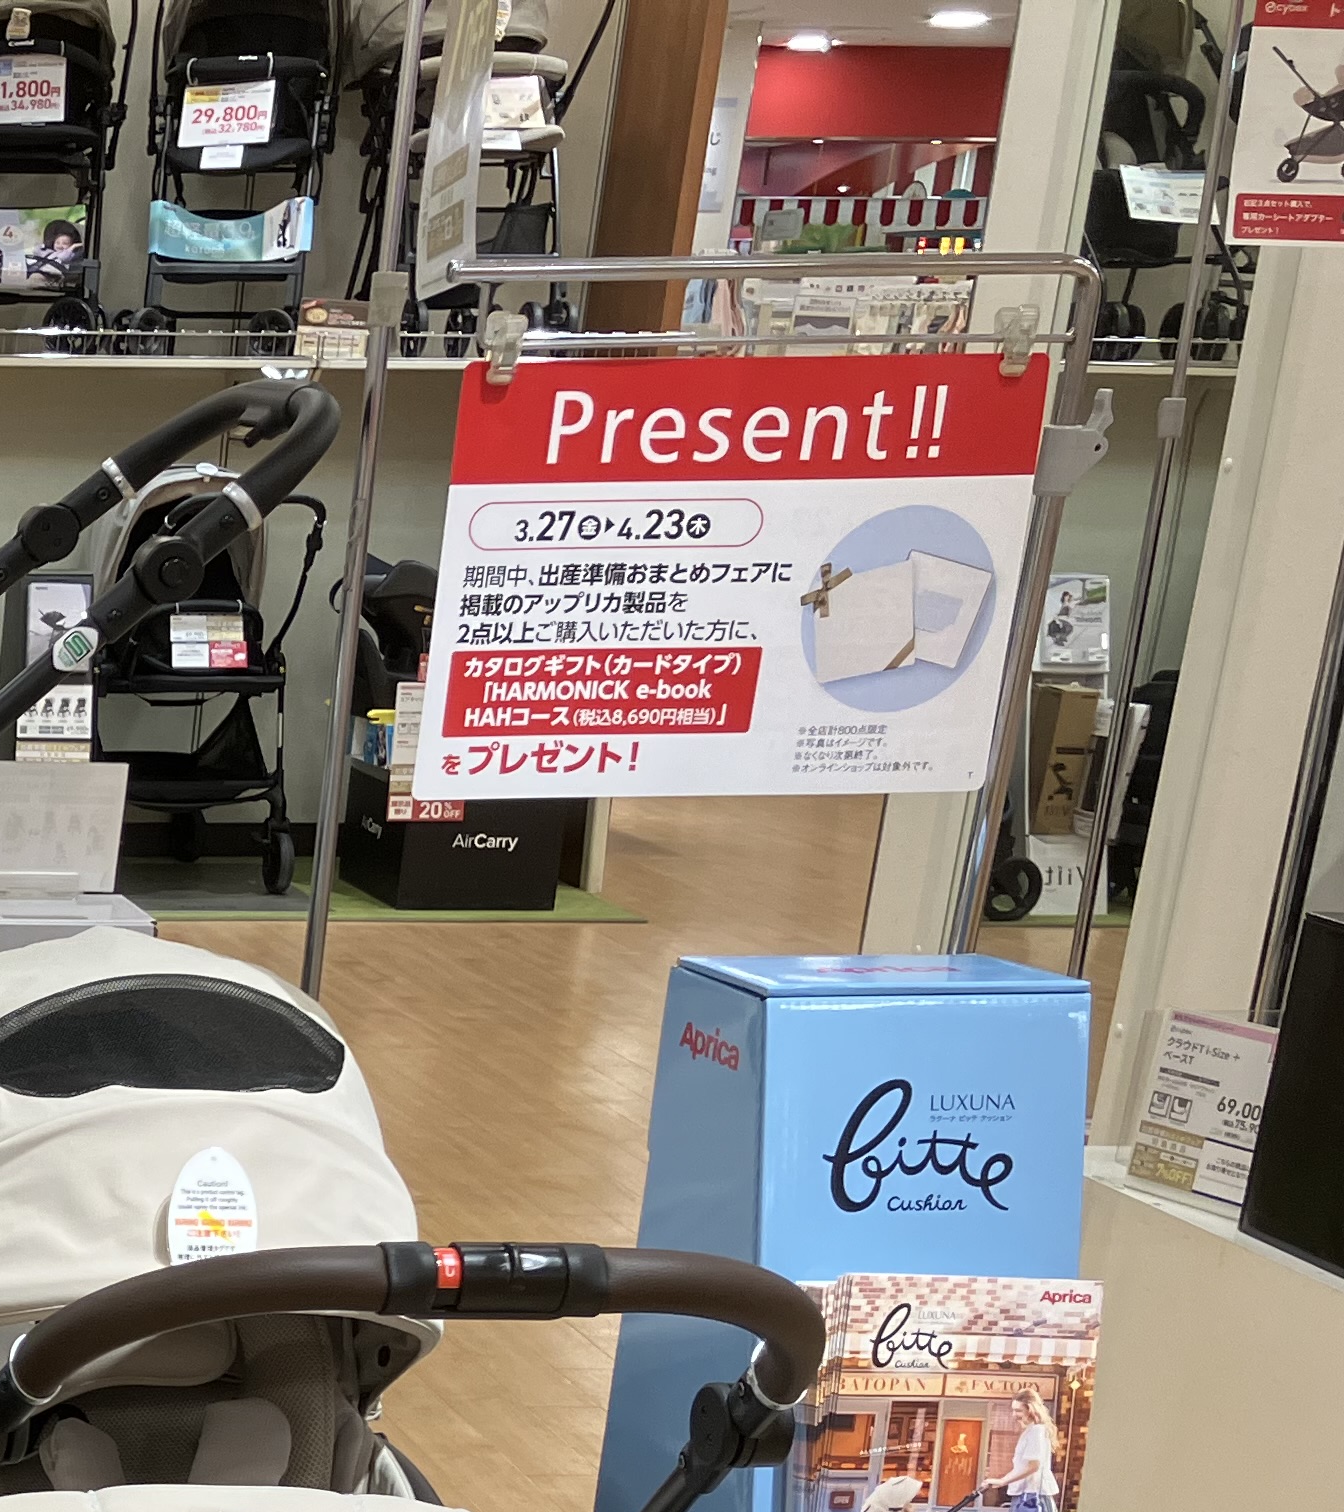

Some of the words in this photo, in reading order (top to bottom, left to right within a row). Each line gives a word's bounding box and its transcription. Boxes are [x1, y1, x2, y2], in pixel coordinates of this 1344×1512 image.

[192, 105, 267, 124] 29,800円
[545, 384, 949, 465] Present!!
[463, 562, 793, 588] 期間中、出産準備おまとめフェアに
[459, 591, 688, 617] 掲載のアップリカ製品を
[456, 621, 759, 644] 2点以上ご購入いただいた方に、
[464, 654, 742, 678] カタログギフト(カードタイプ)
[635, 679, 712, 699] e-book
[441, 741, 640, 775] をプレゼント!
[452, 833, 519, 852] AirCarry
[679, 1021, 740, 1072] Aprica
[929, 1093, 1015, 1112] LUXUNA
[887, 1193, 968, 1212] Cushion
[1040, 1290, 1092, 1305] Aprica
